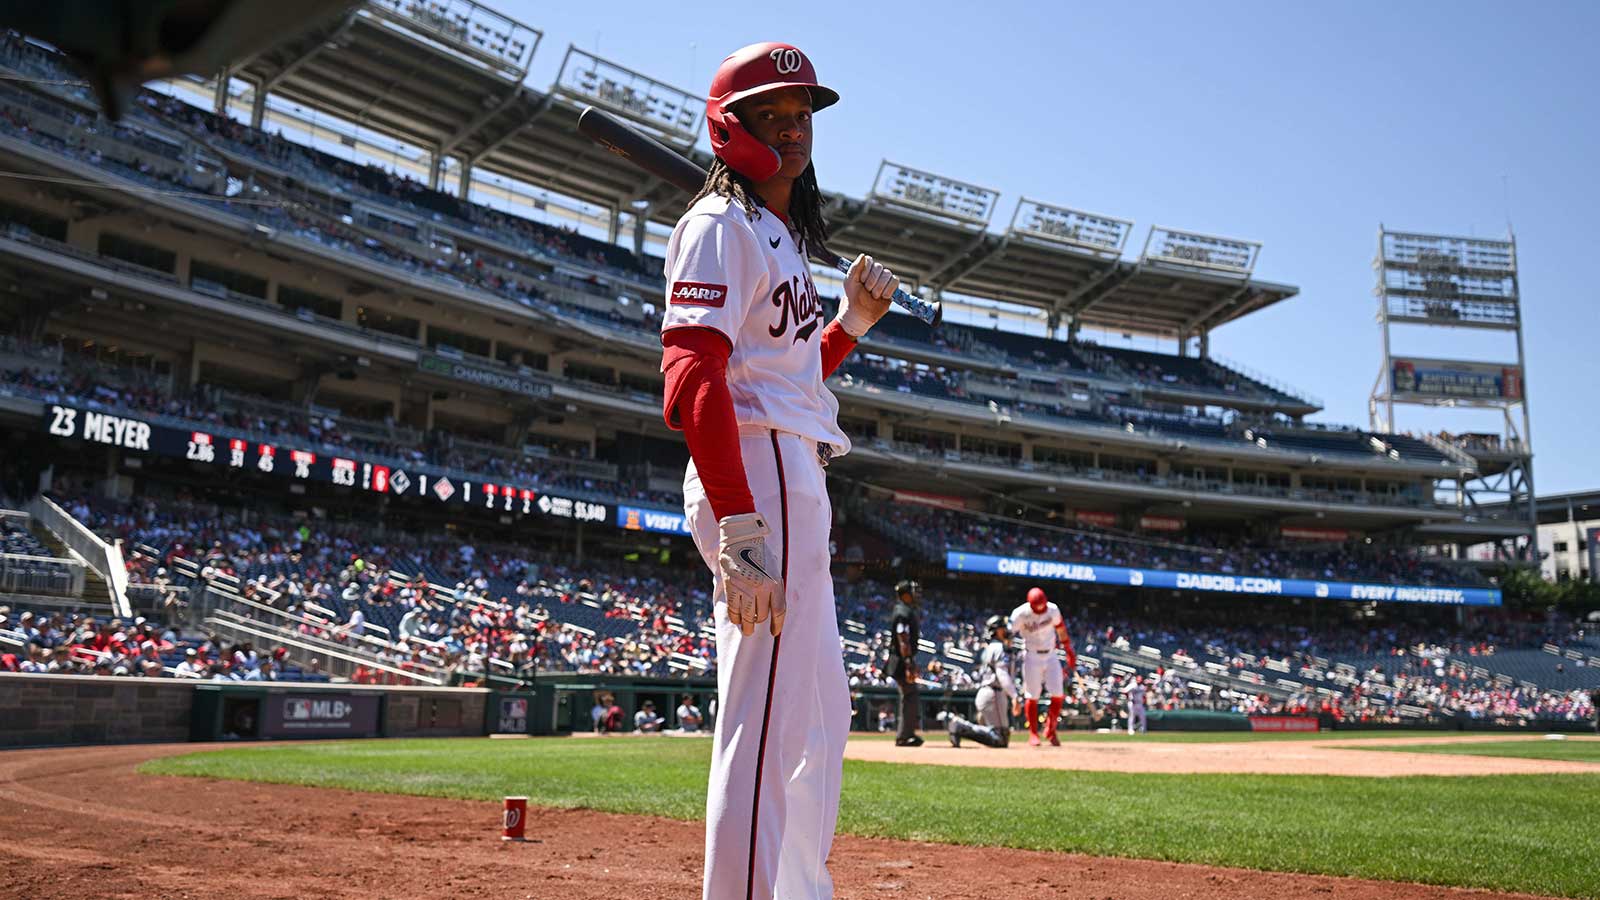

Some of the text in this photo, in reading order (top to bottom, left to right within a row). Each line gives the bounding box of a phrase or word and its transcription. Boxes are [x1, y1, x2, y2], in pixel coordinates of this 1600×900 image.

[769, 48, 802, 74] W
[673, 286, 723, 301] AARP
[50, 405, 151, 450] 23 MEYER
[375, 470, 386, 492] 6
[419, 474, 427, 496] 1
[463, 482, 471, 502] 1
[644, 512, 681, 531] VISIT
[998, 557, 1097, 581] ONE SUPPLIER.
[1351, 584, 1464, 604] EVERY INDUSTRY.
[312, 699, 352, 719] MLB+
[499, 718, 527, 732] MLB
